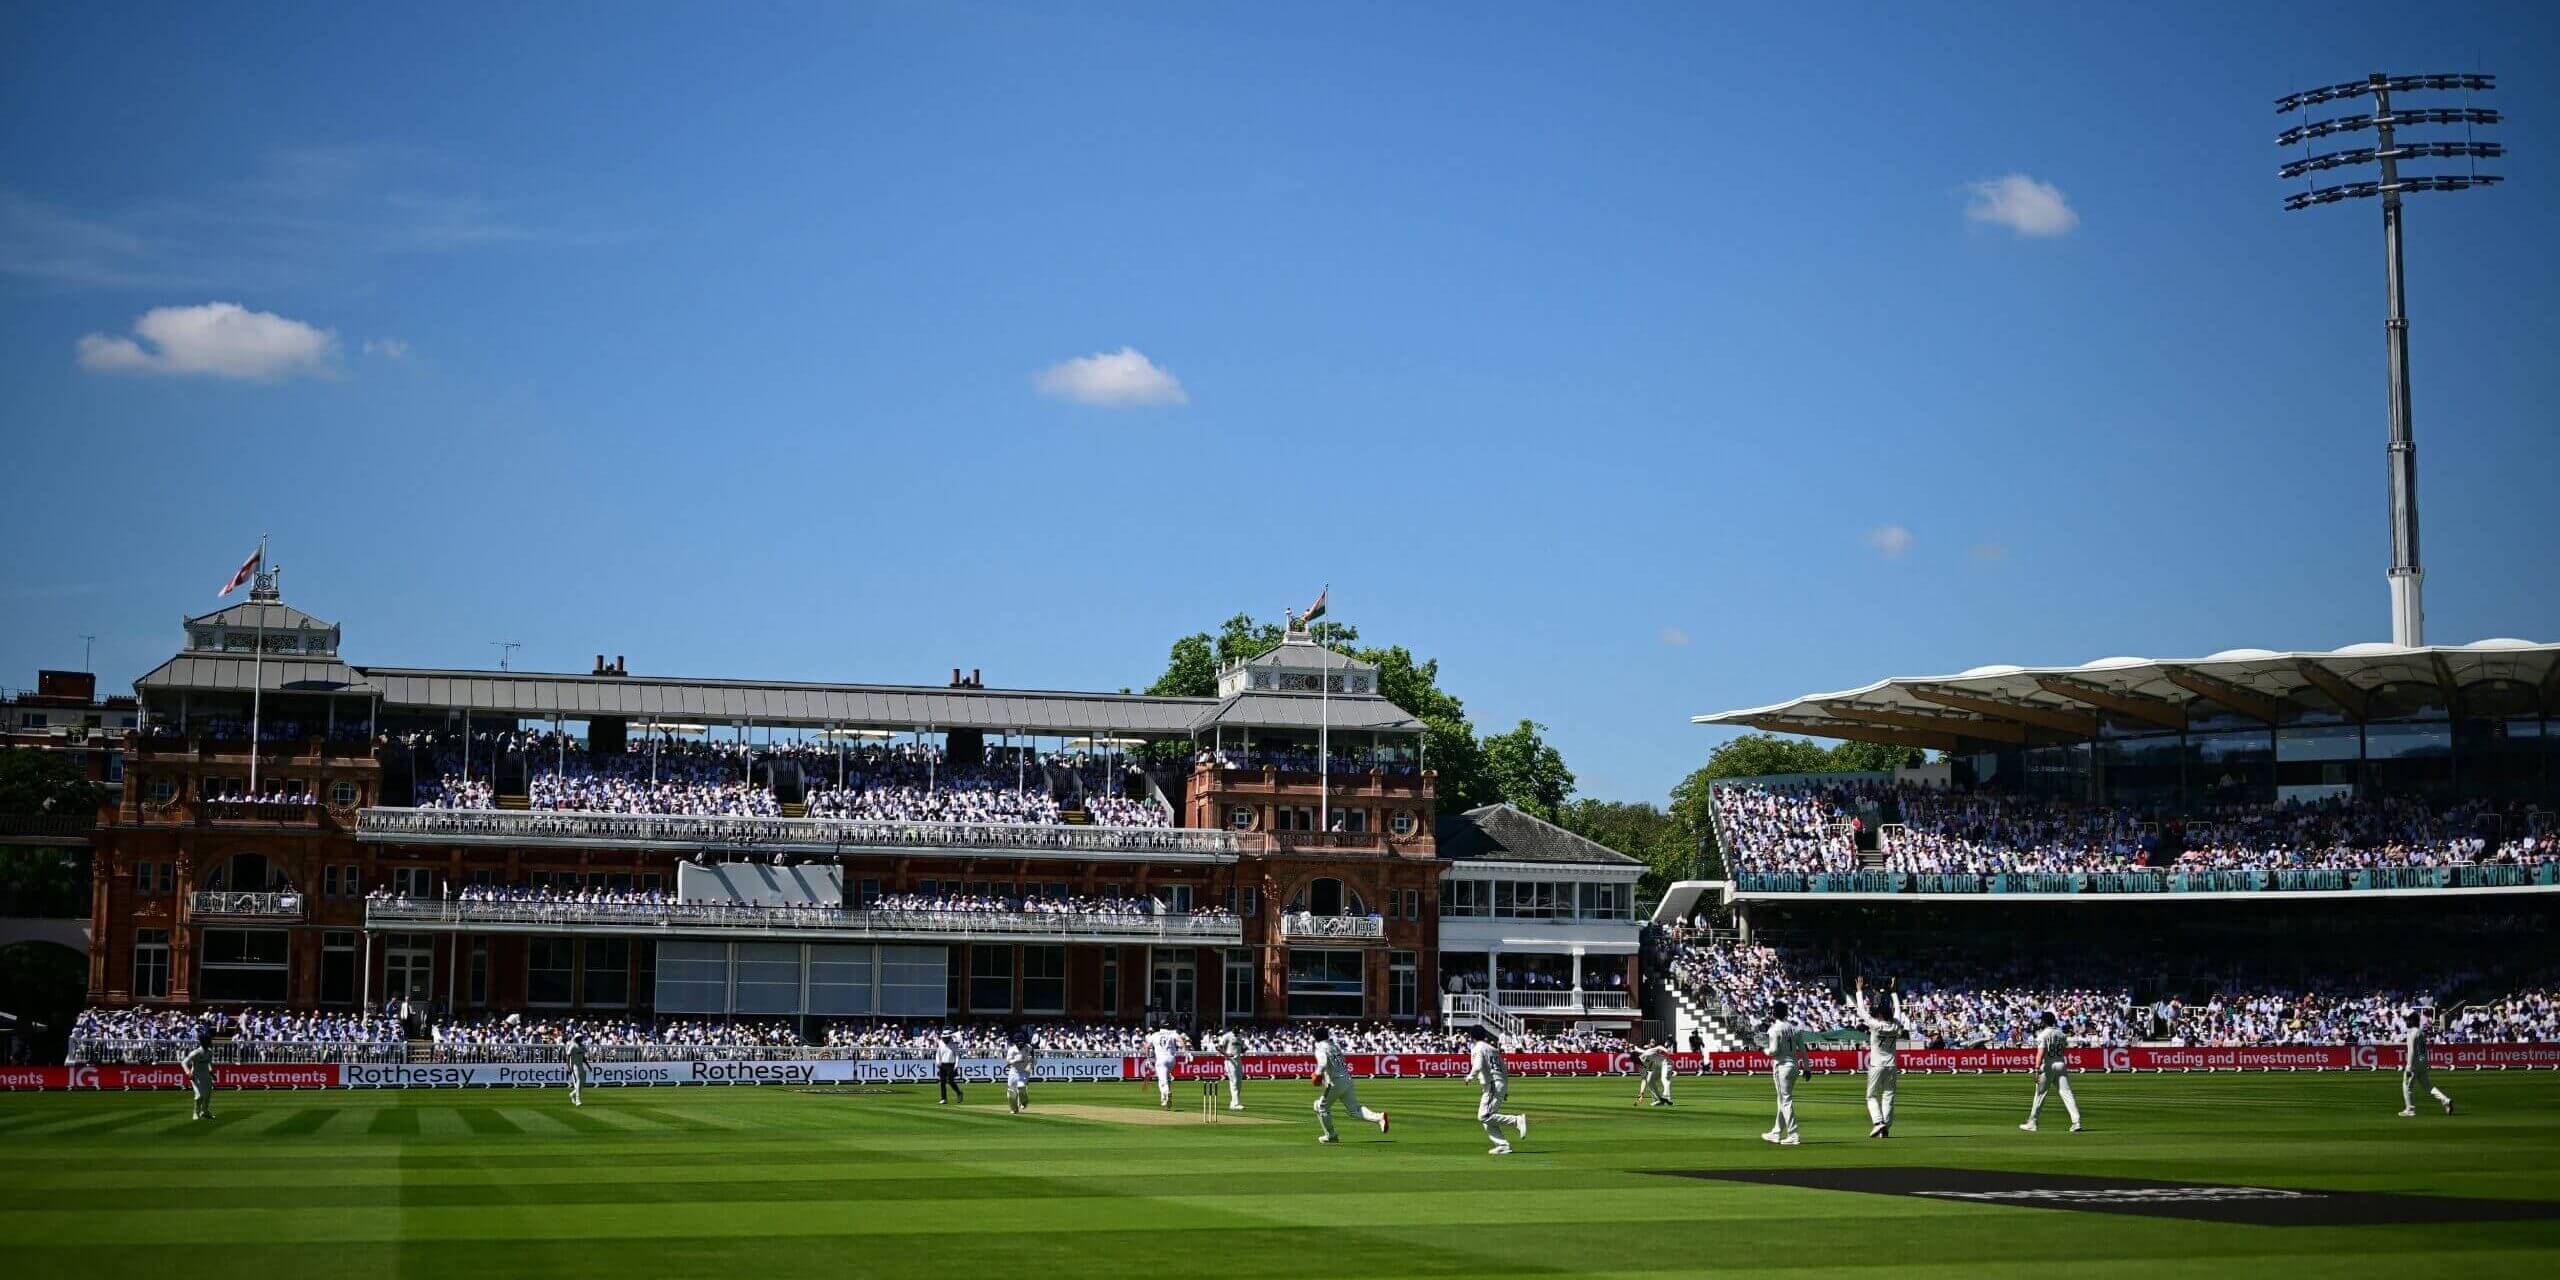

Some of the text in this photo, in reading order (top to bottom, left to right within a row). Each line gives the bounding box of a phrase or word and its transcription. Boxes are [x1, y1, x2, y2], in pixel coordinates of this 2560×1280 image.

[1738, 873, 1801, 892] BREWDOG
[1827, 873, 1890, 892] BREWDOG
[1916, 873, 1980, 892] BREWDOG
[2006, 873, 2070, 892] BREWDOG
[2096, 873, 2160, 892] BREWDOG
[2187, 872, 2251, 892] BREWDOG
[2278, 870, 2343, 890] BREWDOG
[2370, 868, 2434, 889] BREWDOG
[2460, 866, 2525, 887] BREWDOG
[1374, 1055, 1401, 1075] IG
[1416, 1058, 1470, 1074] Trading
[1608, 1053, 1635, 1073] IG
[1718, 1056, 1745, 1069] and
[1900, 1053, 1956, 1069] Trading
[1960, 1054, 1987, 1066] and
[2103, 1048, 2329, 1070] IG Trading and investments
[2351, 1046, 2378, 1068] IG
[2458, 1048, 2487, 1061] and
[2491, 1048, 2560, 1061] investme
[68, 1066, 100, 1087] IG
[119, 1070, 184, 1086] Trading
[225, 1070, 327, 1083] investments
[347, 1065, 475, 1085] Rothesay
[593, 1066, 669, 1081] Pensions
[692, 1062, 814, 1082] Rothesay
[858, 1063, 889, 1078] The
[894, 1063, 928, 1078] UK's
[1061, 1062, 1118, 1076] insurer
[1177, 1061, 1229, 1074] Tradin
